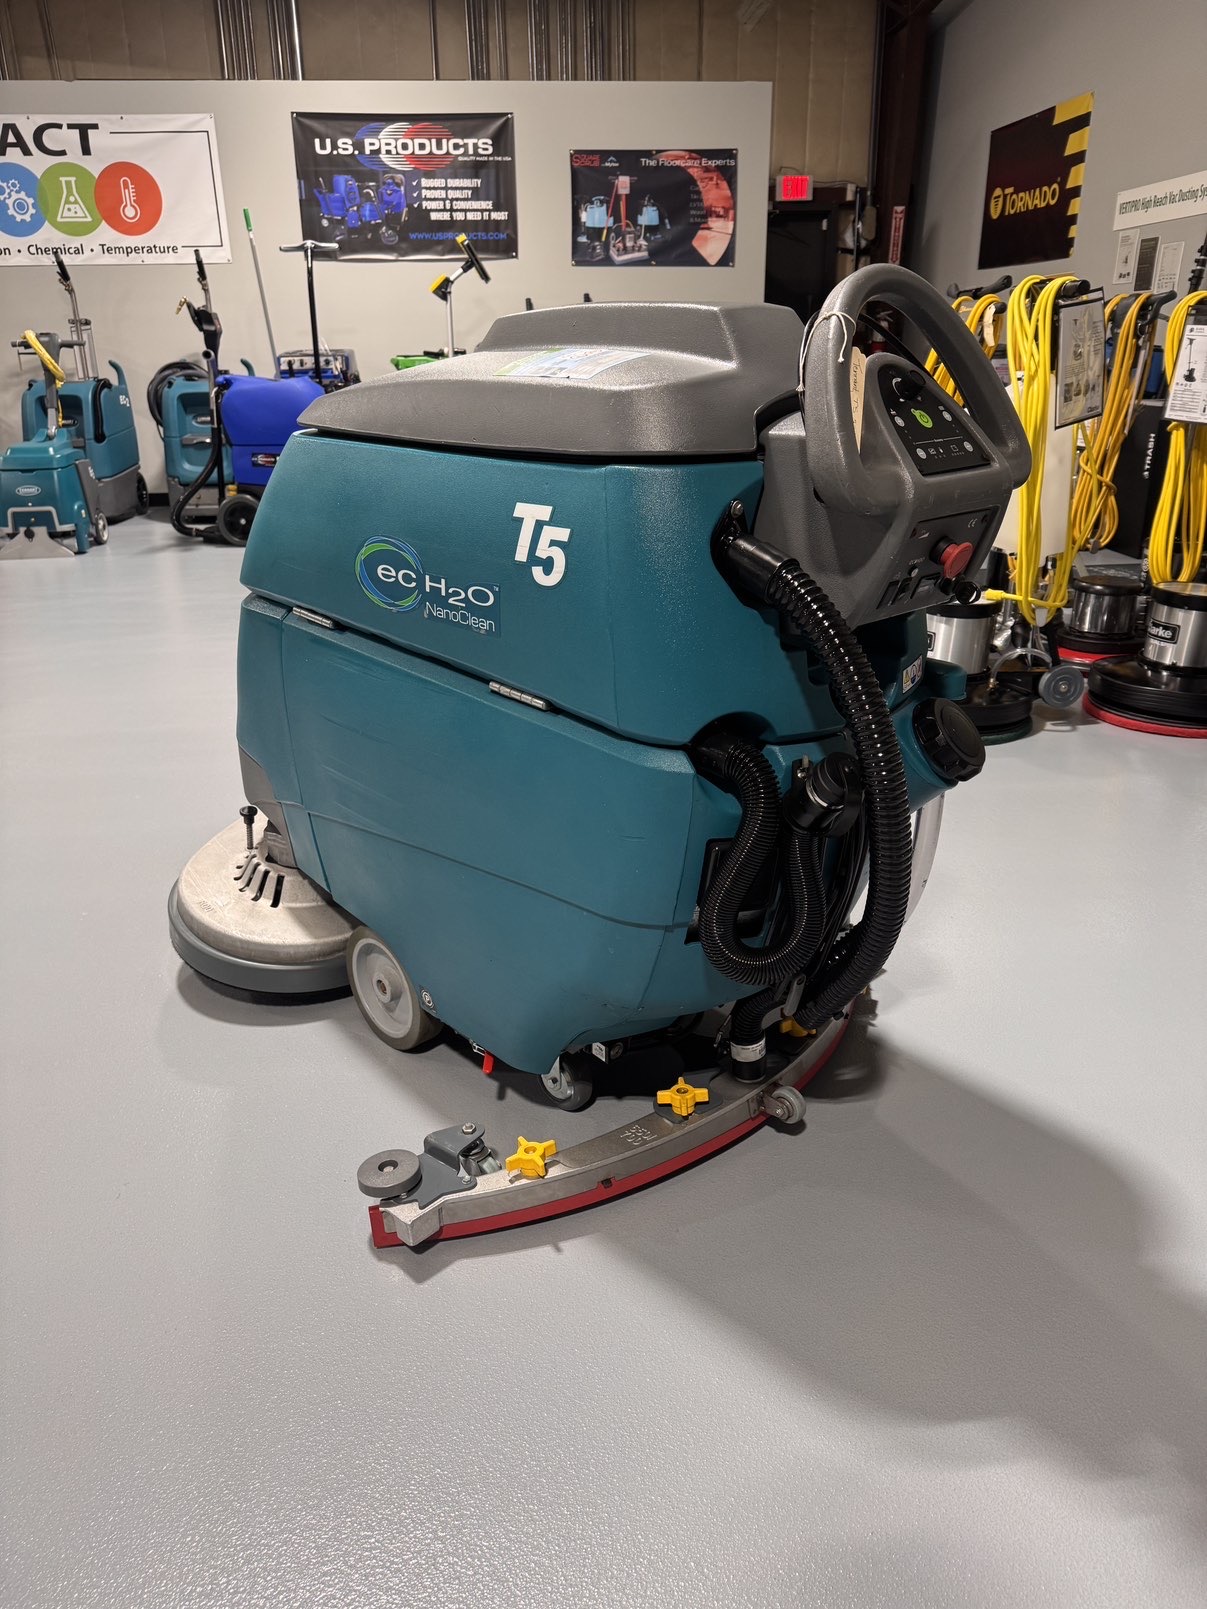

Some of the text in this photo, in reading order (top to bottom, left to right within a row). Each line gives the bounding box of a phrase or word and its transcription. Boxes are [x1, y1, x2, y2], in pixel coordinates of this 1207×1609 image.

[0, 123, 99, 157] ACT
[314, 138, 493, 155] U.S. PRODUCTS
[640, 158, 735, 167] The Floorcare Experts
[421, 177, 481, 188] RUGGED DURABILITY
[421, 189, 472, 199] PROVEN QUALITY
[1119, 198, 1142, 215] VERTIPRO
[1141, 196, 1153, 213] High
[1153, 192, 1169, 208] Reach
[1169, 191, 1179, 205] Vac
[1178, 187, 1199, 203] Dusting
[422, 200, 493, 209] POWER & CONVENIENCE
[430, 211, 508, 220] WHERE YOU NEED IT MOST
[409, 232, 507, 240] WWW.USPROUCTS.COM
[27, 243, 84, 256] Chemical
[99, 243, 178, 257] Temperature
[1144, 433, 1156, 470] TRASH
[512, 502, 572, 587] T5
[377, 564, 417, 588] ec
[426, 601, 495, 632] NanoClean
